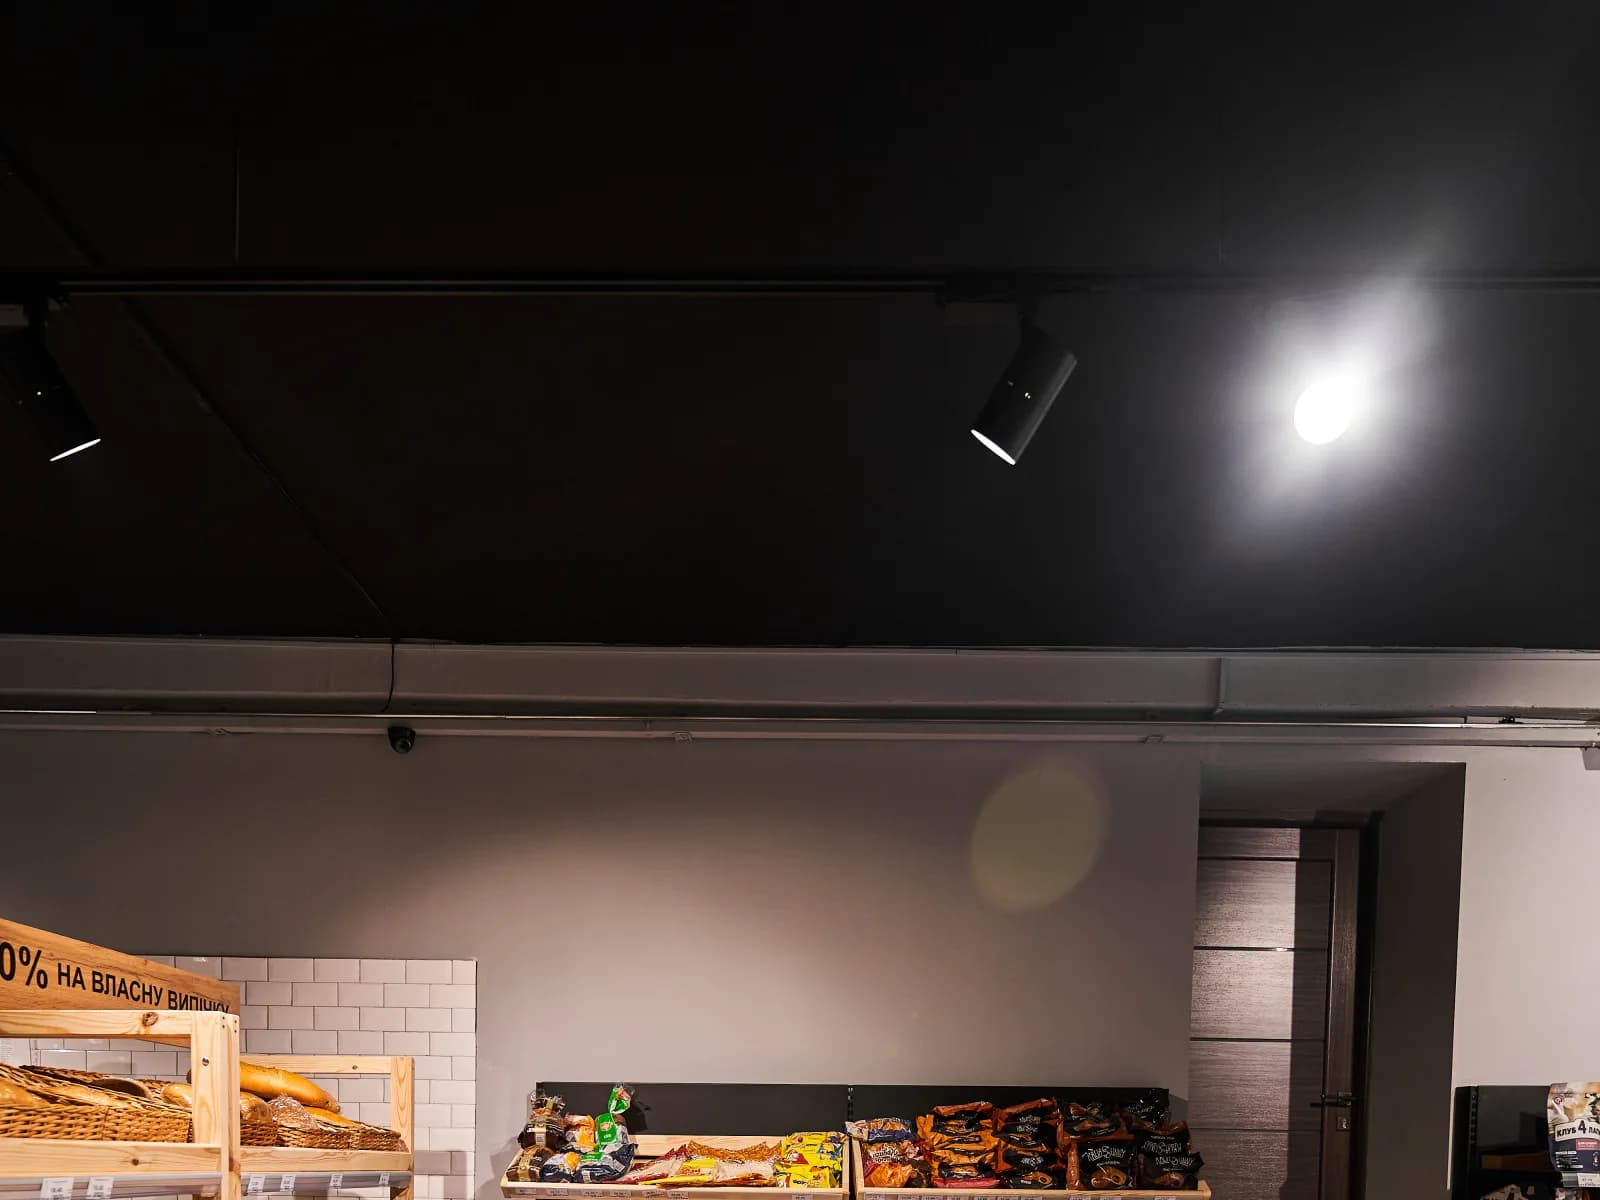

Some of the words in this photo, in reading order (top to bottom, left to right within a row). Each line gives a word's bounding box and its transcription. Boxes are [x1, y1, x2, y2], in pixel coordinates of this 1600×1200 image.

[57, 962, 86, 990] НА
[92, 971, 163, 1006] ВЛАСНУ
[1578, 1120, 1586, 1134] 4
